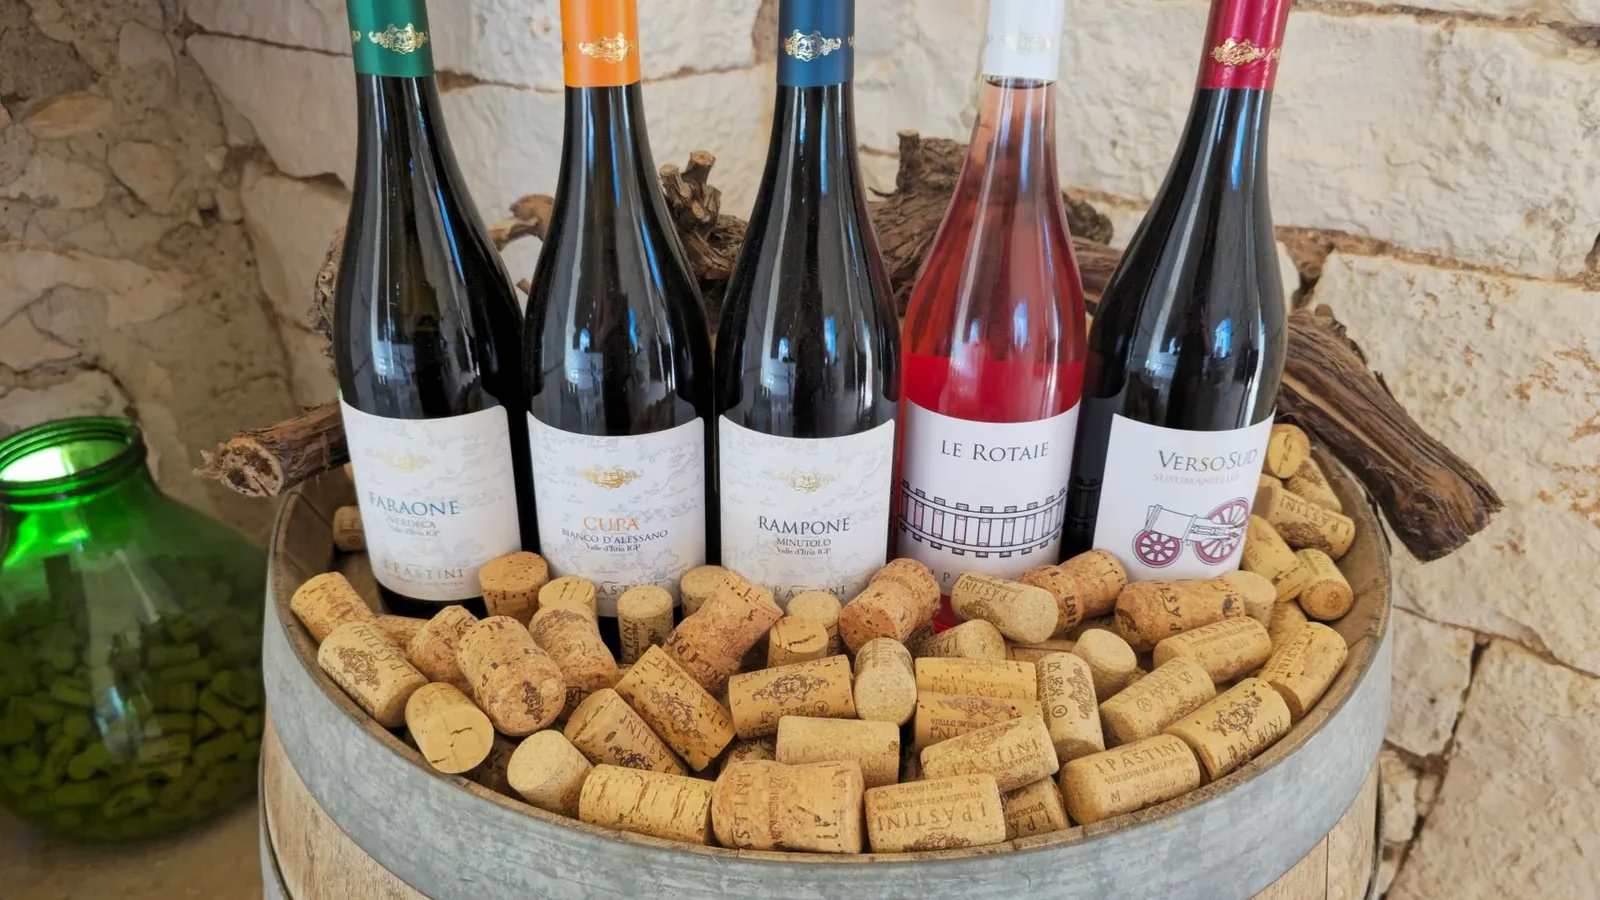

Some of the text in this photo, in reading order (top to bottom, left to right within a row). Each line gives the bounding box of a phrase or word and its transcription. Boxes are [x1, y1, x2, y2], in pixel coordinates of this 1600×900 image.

[941, 439, 1050, 462] LE ROTAIE
[368, 490, 461, 517] FARAONE
[583, 516, 640, 532] CUPA
[758, 515, 851, 536] RAMPONE
[562, 527, 669, 544] BIANCO D'ALESSANO
[776, 537, 832, 548] MINUTOLO
[626, 543, 642, 552] IGP
[776, 546, 793, 554] Valle
[817, 547, 832, 556] IGP
[1106, 741, 1185, 772] PASTINI
[877, 807, 973, 831] PASTINI
